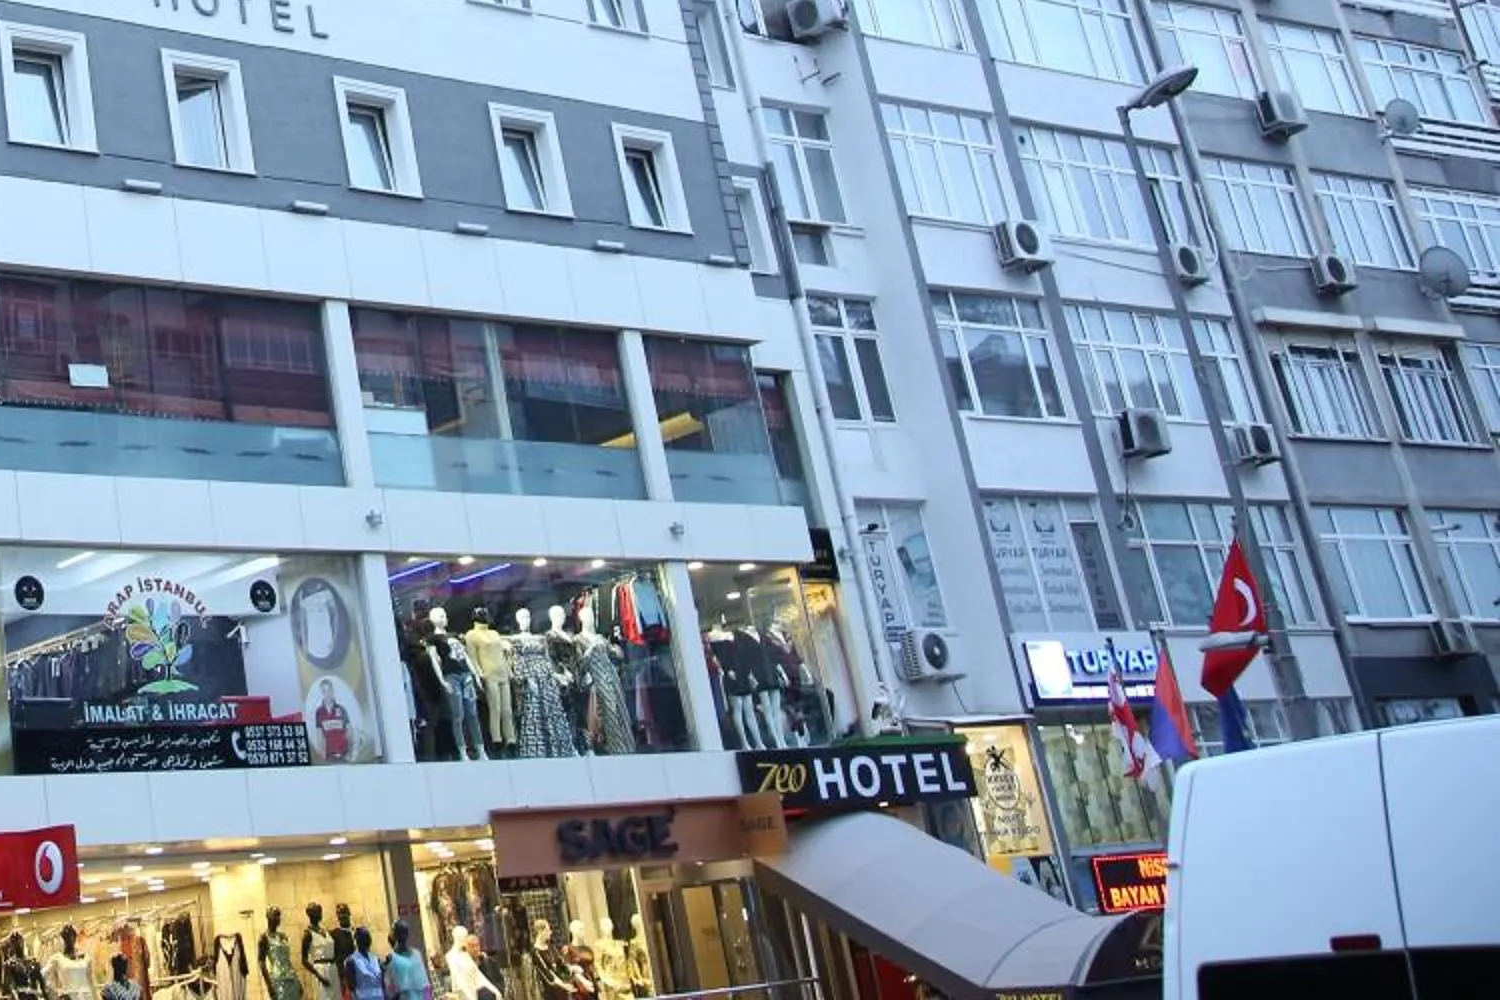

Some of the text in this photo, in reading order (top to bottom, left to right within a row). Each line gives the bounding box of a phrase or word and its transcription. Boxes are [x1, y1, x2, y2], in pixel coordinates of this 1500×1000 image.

[867, 541, 896, 622] TURYAP
[103, 584, 134, 631] ARAP
[83, 699, 239, 723] İMALAT & İHRACAT
[813, 751, 967, 800] HOTEL
[556, 806, 679, 863] SAGE
[1110, 886, 1160, 908] BAYAN
